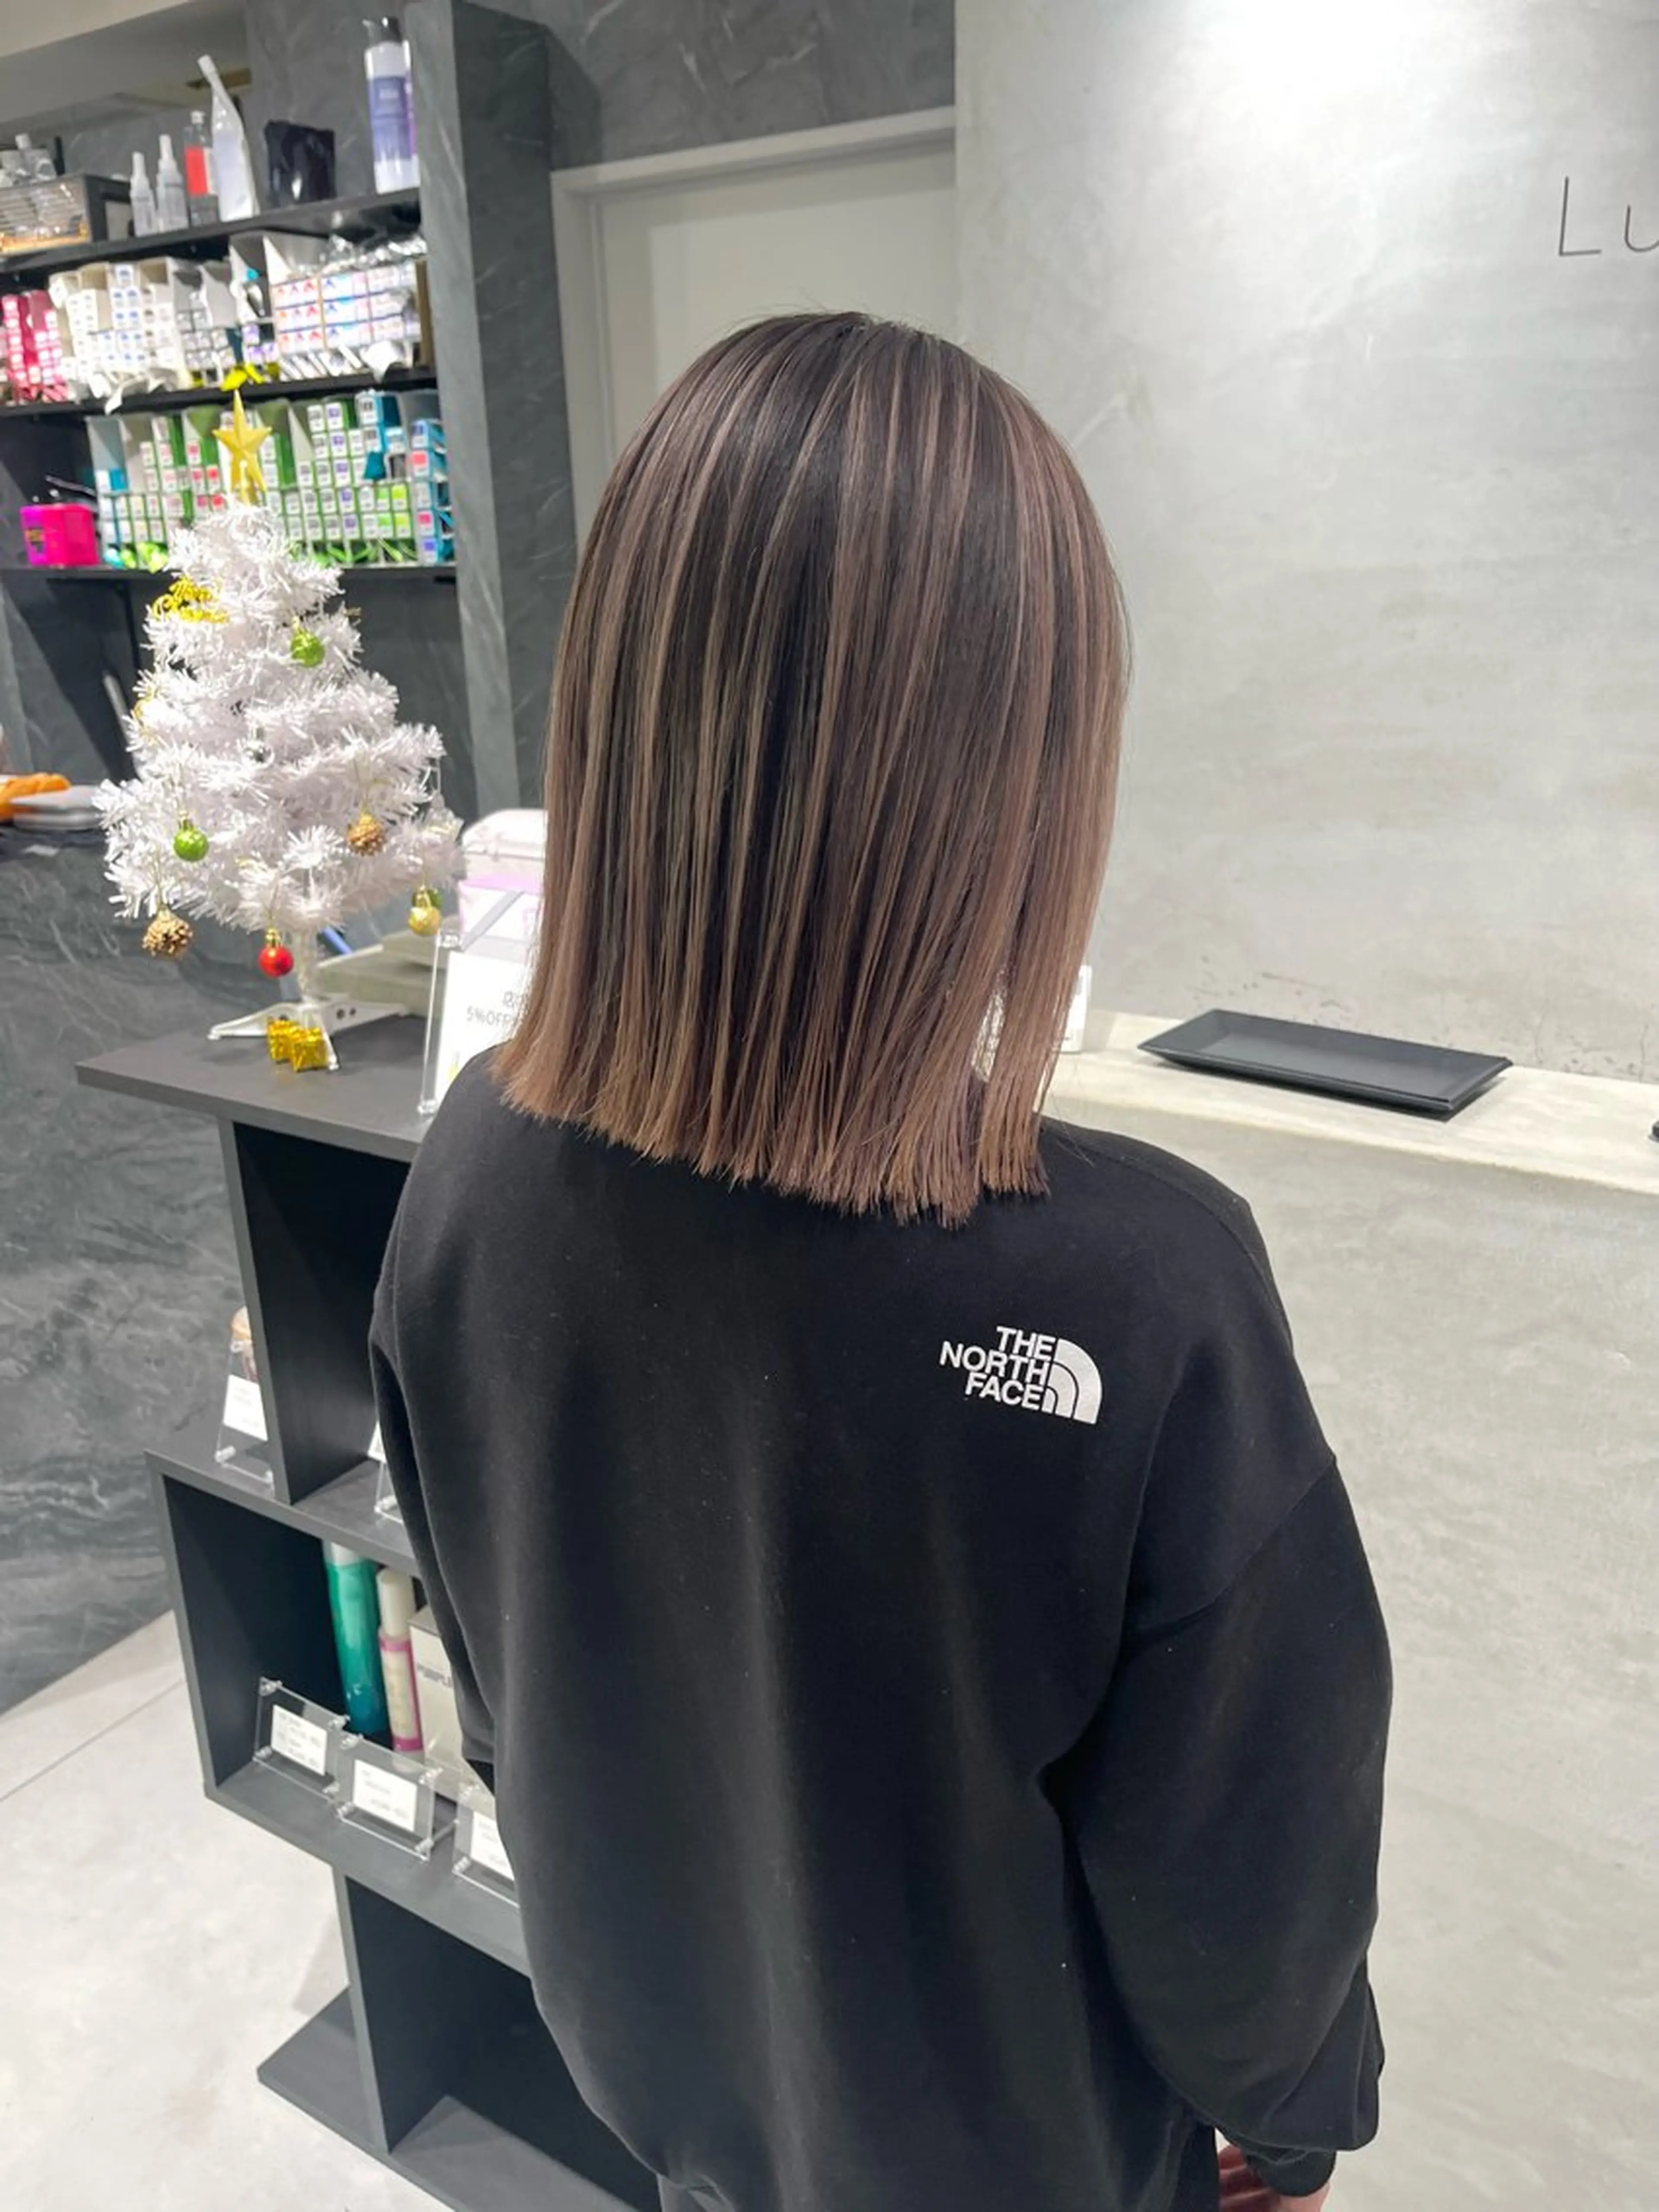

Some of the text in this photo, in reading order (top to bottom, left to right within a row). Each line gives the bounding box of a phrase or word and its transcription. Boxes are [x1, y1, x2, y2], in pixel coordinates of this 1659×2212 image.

[996, 1325, 1056, 1361] THE
[939, 1341, 1050, 1387] NORTH
[965, 1373, 1043, 1411] FACE
